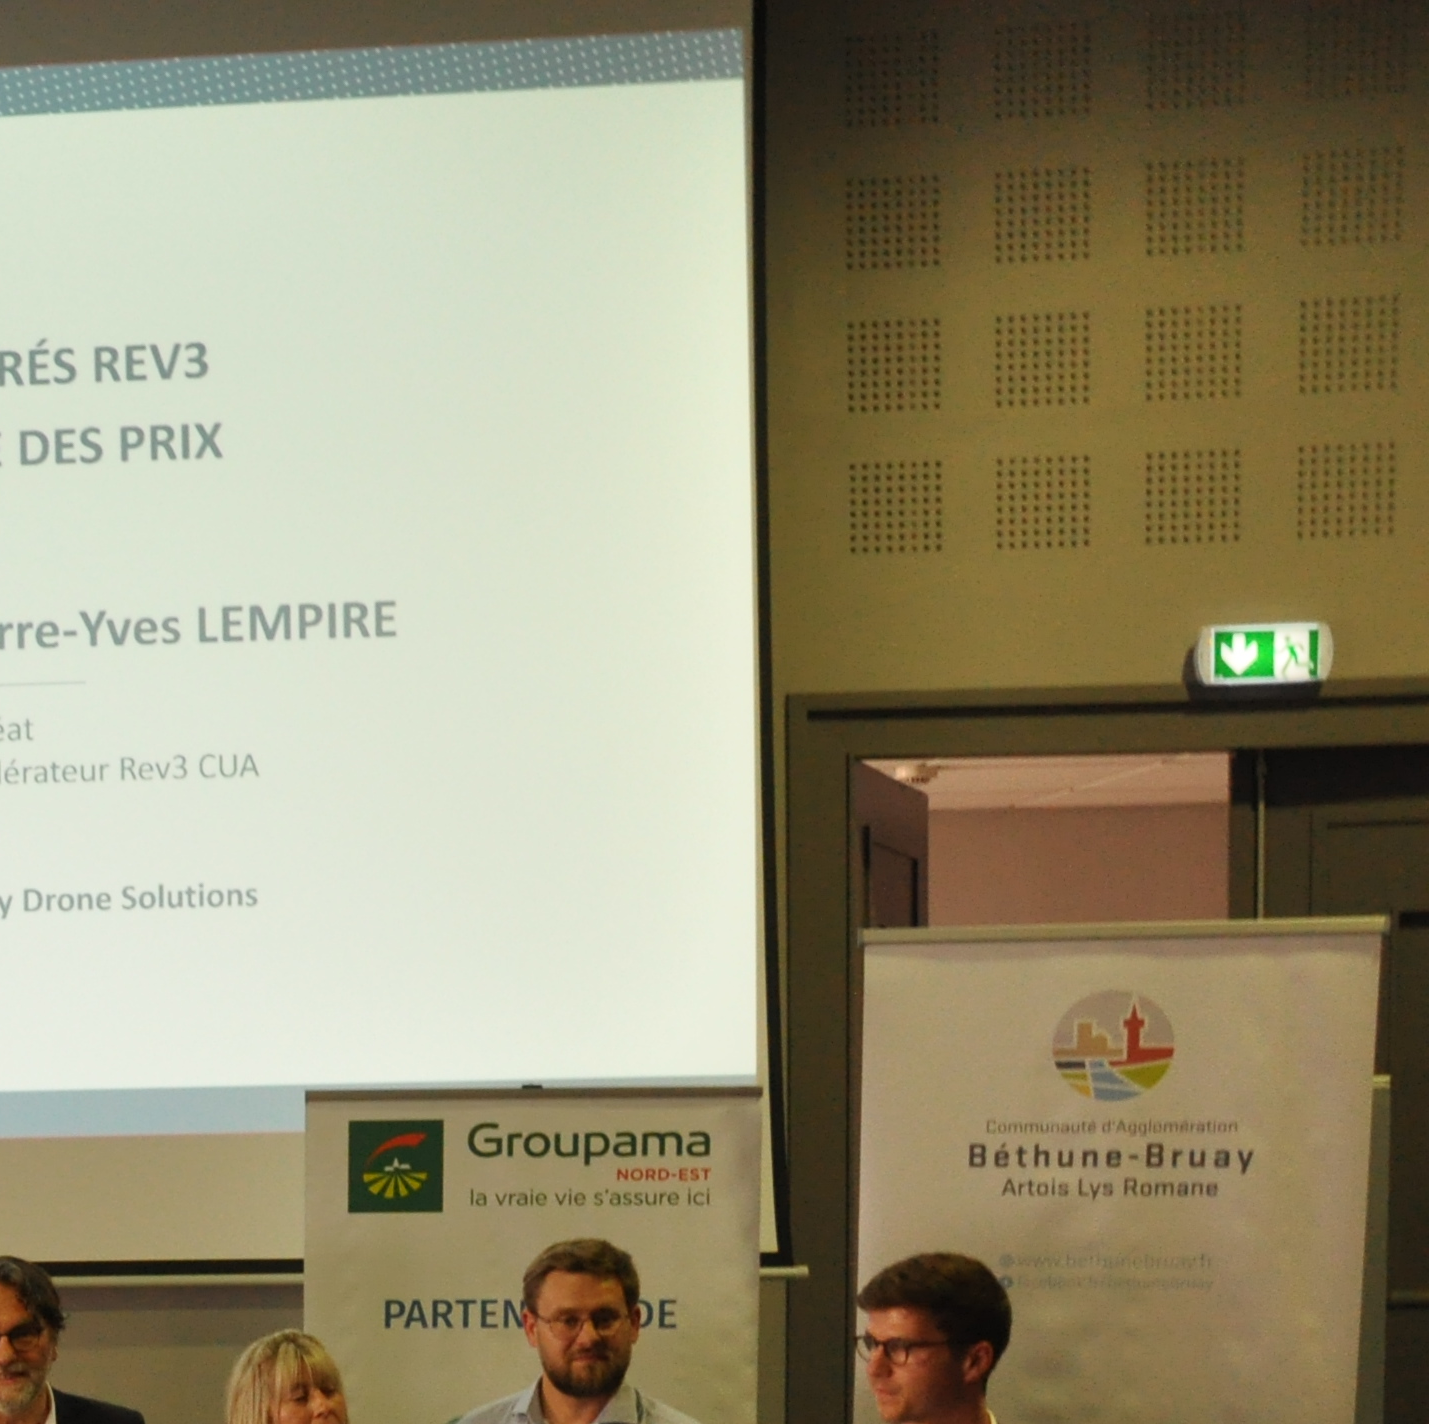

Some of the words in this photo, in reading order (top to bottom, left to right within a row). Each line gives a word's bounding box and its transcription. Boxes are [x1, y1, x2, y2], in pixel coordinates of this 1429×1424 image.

[92, 339, 211, 386] REV3
[17, 424, 104, 469] DES
[117, 421, 225, 464] PRIX
[195, 599, 400, 647] LEMPIRE
[118, 751, 191, 784] Rev3
[196, 750, 260, 783] CUA
[21, 884, 114, 915] Drone
[120, 880, 261, 912] Solutions
[467, 1121, 713, 1167] Groupama
[985, 1119, 1096, 1135] Communauté
[1100, 1118, 1240, 1138] d'Agglomération
[615, 1166, 712, 1182] NORD-EST
[967, 1141, 1255, 1175] Béthune-Bruay
[469, 1188, 488, 1207] la
[494, 1188, 548, 1207] vraie
[554, 1188, 587, 1207] vie
[593, 1188, 681, 1207] s'assure
[687, 1187, 712, 1207] ici
[1000, 1177, 1070, 1198] Artois
[1077, 1177, 1115, 1201] Lys
[1122, 1177, 1220, 1198] Romane
